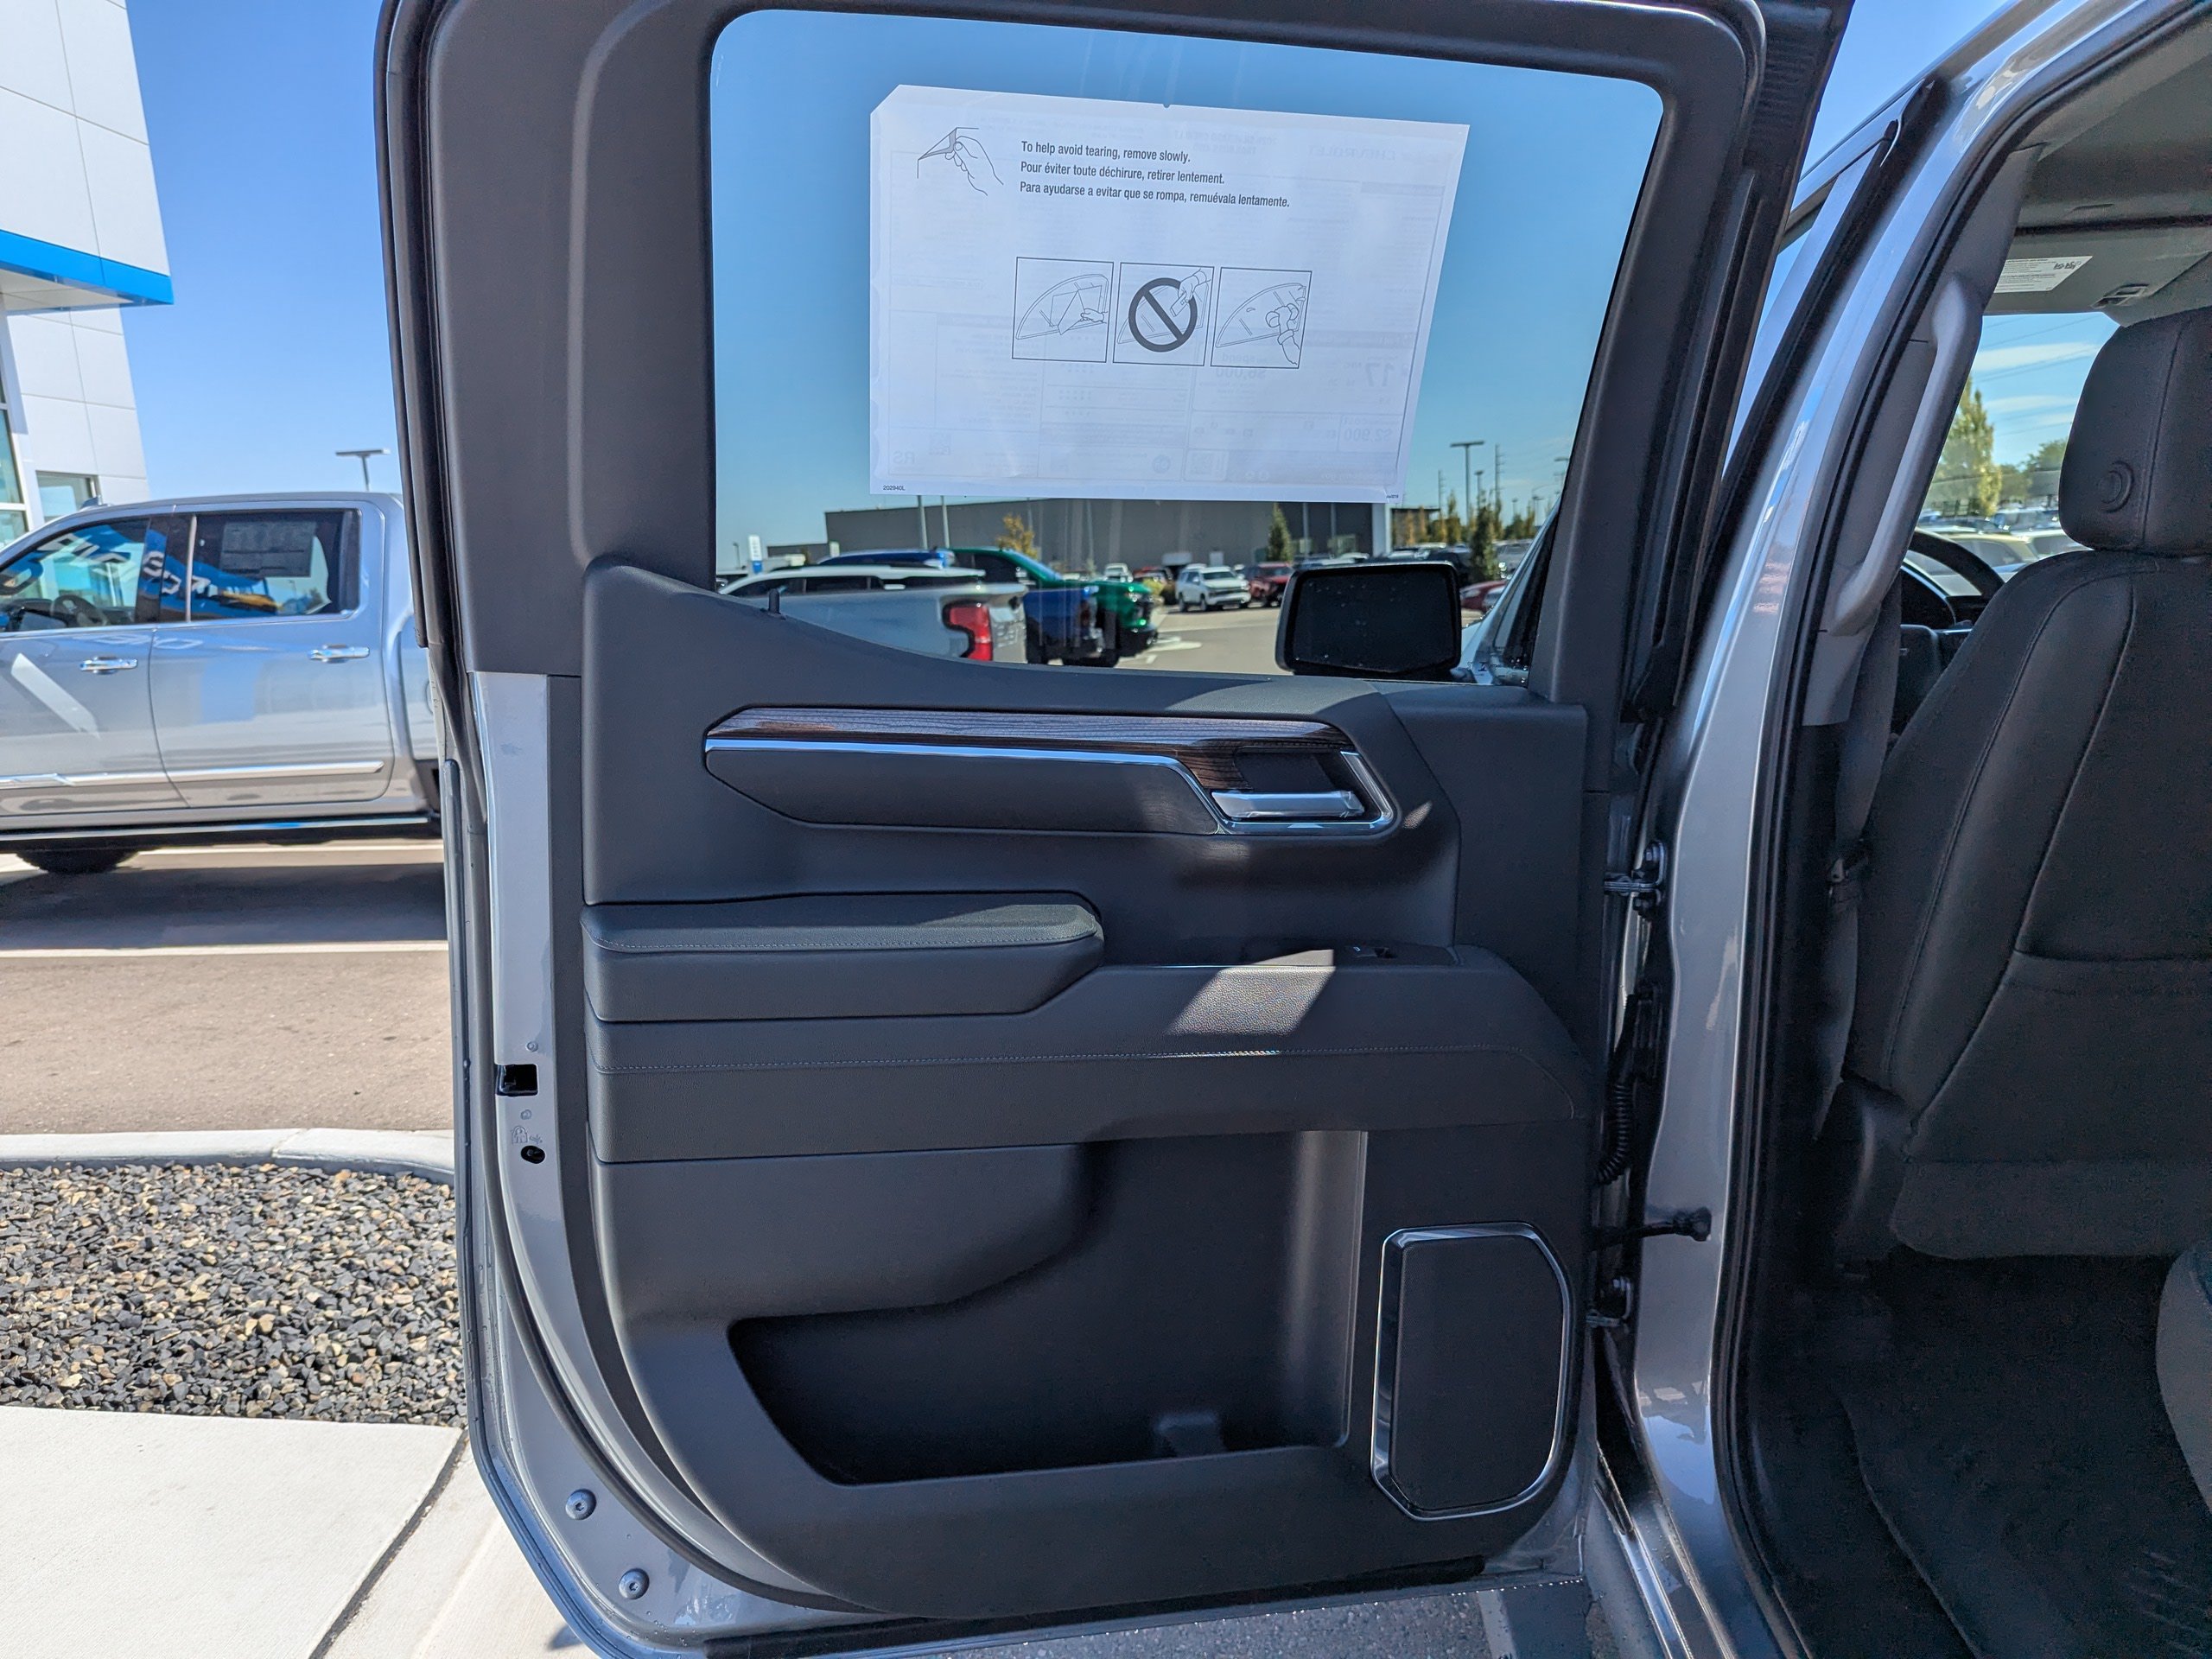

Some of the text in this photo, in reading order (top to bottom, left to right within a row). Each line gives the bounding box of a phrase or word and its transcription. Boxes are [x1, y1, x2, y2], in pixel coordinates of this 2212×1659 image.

[1021, 141, 1191, 164] To help avoid tearing, remove slowly.
[1020, 161, 1225, 184] Pour éviter toute déchirure, retirer lentement.
[1020, 181, 1290, 207] Para ayudarse a evitar que se rompa, remuévala lentamente.
